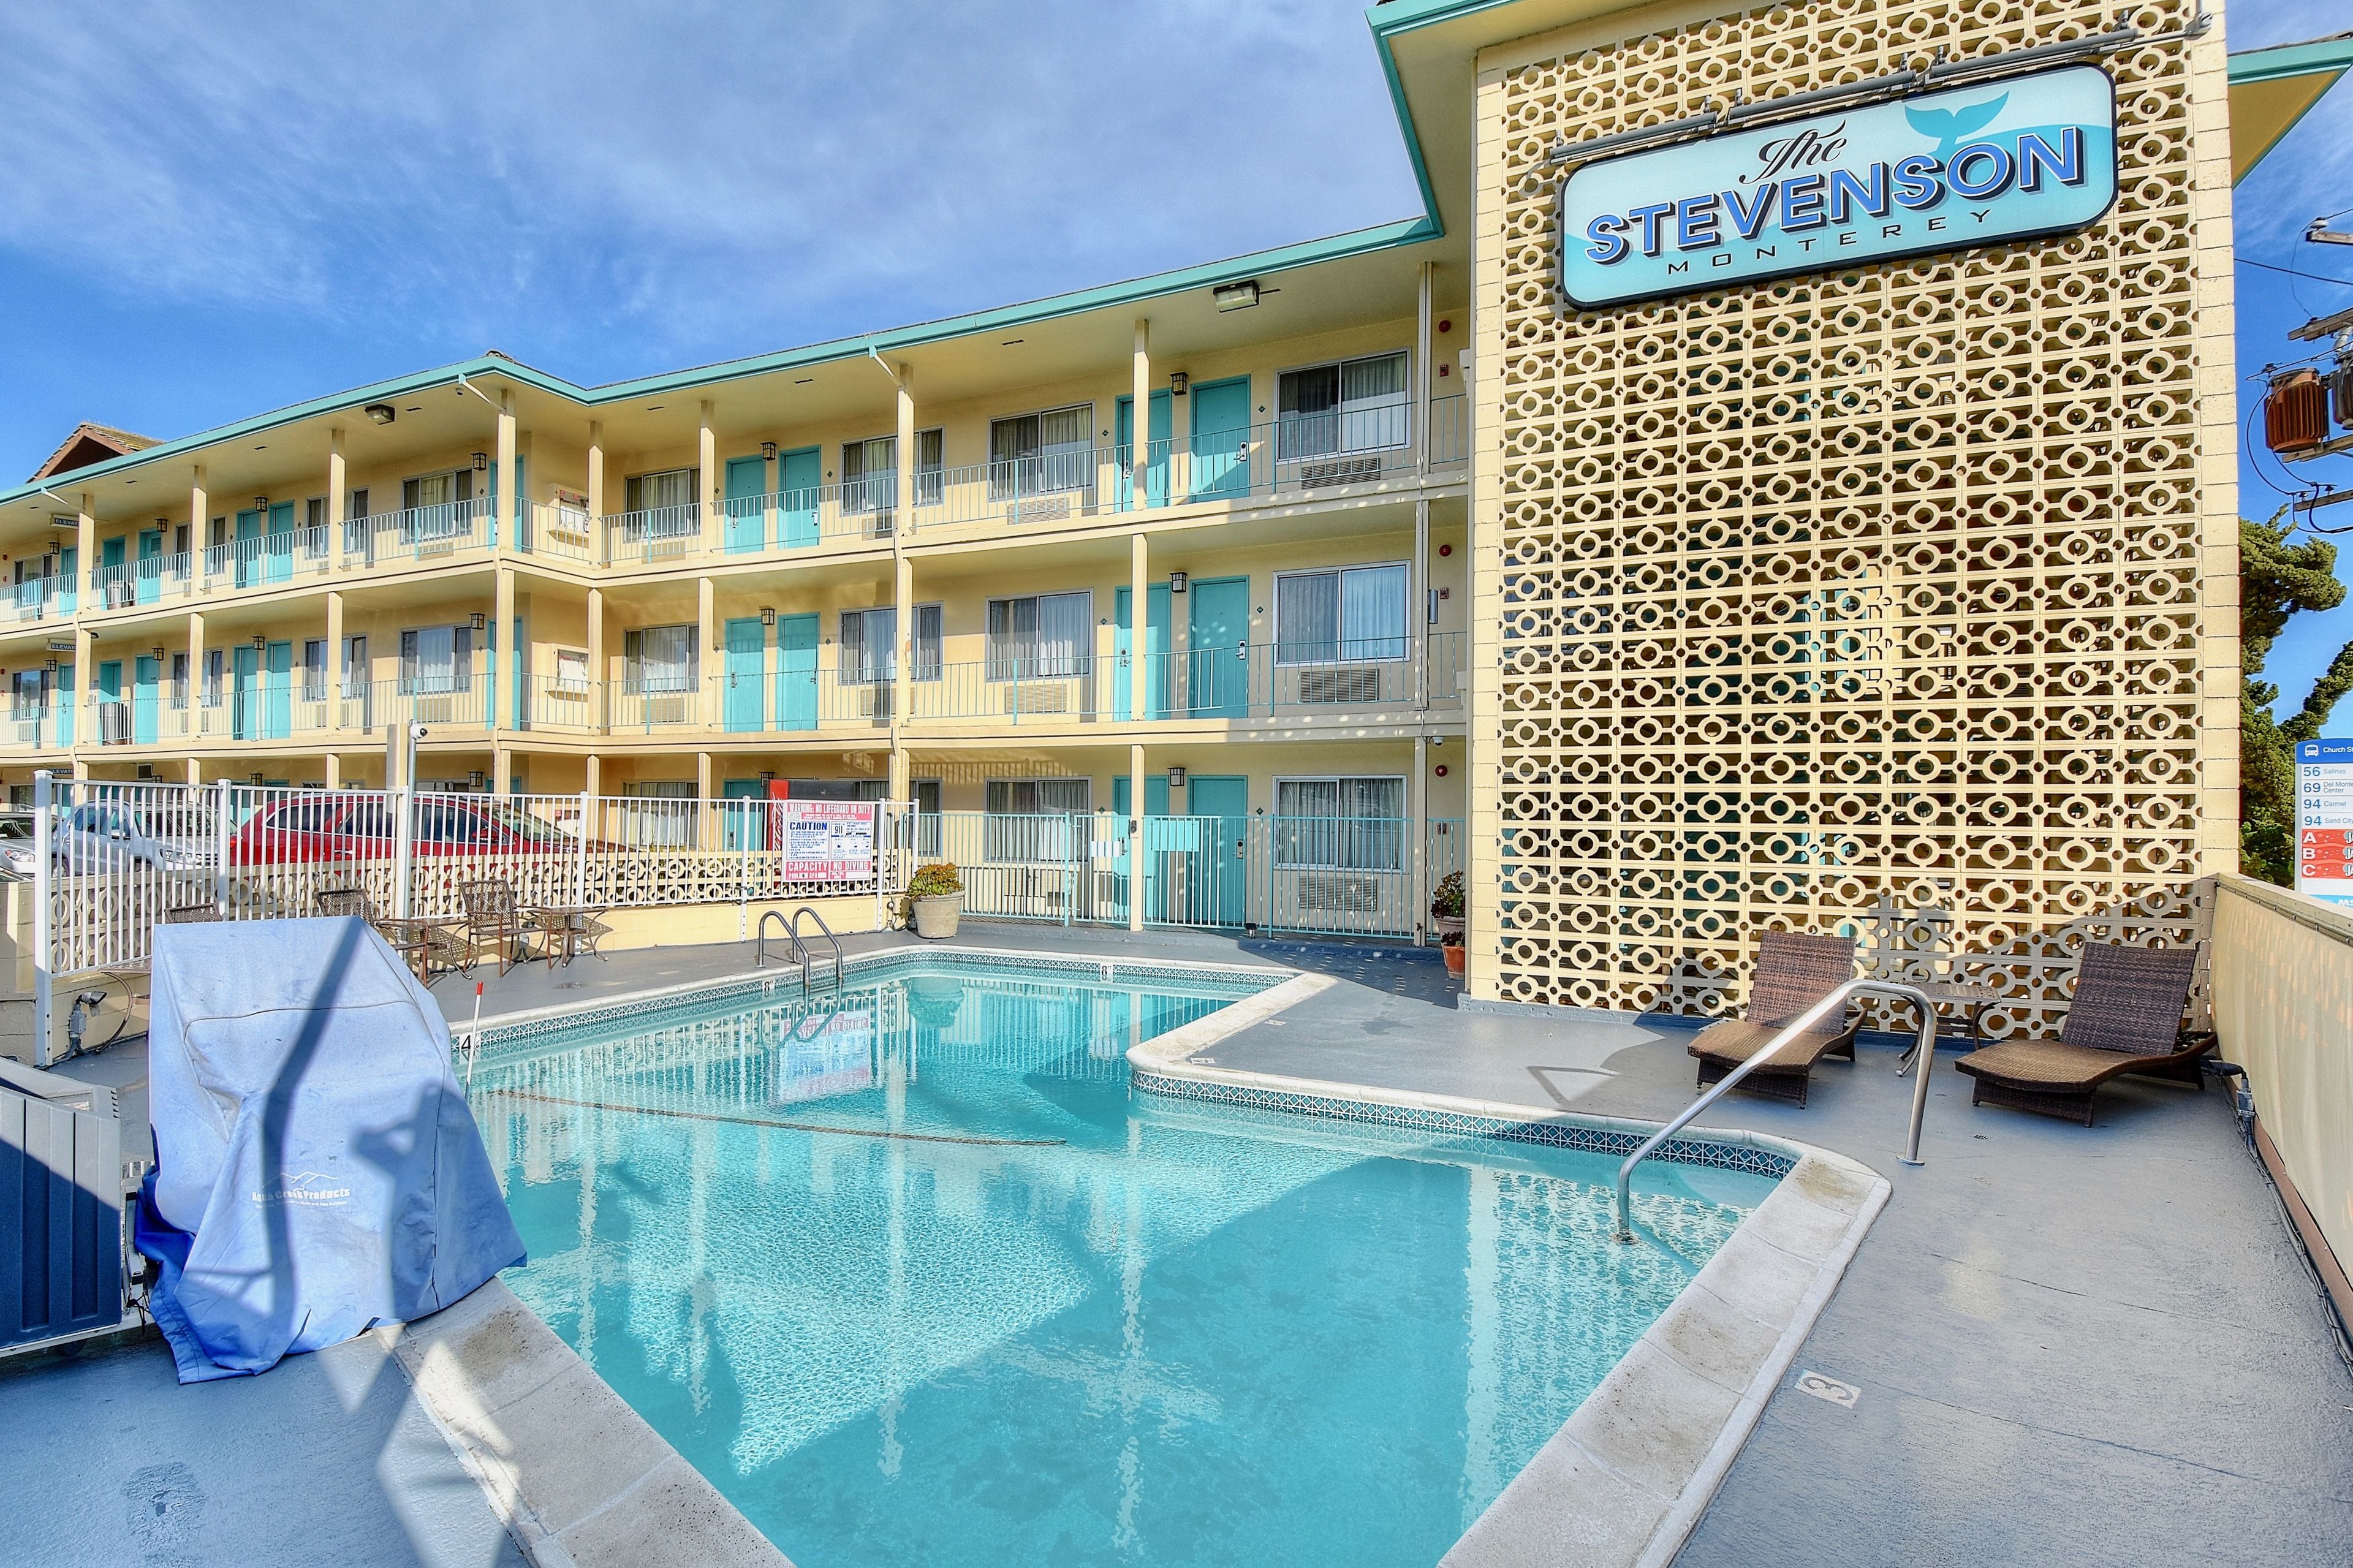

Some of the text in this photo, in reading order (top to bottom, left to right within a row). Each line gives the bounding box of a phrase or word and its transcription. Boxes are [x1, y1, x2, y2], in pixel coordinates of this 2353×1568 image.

[1738, 119, 1848, 184] The
[1585, 124, 2087, 266] STEVENSON
[1667, 208, 1993, 275] MONTEREY
[2303, 767, 2321, 776] 56
[2303, 782, 2321, 793] 69
[789, 803, 871, 814] WARNING: NO LIFEGUARD ON DUTY
[2303, 798, 2321, 809] 94
[790, 822, 827, 830] CAUTION
[2304, 816, 2322, 826] 94
[2303, 831, 2317, 844] A
[2302, 847, 2316, 860] B
[788, 862, 828, 871] CAPACITY
[833, 861, 868, 871] NO DIVING
[2302, 864, 2316, 876] C
[252, 1191, 274, 1202] Aqua
[303, 1187, 350, 1200] Products
